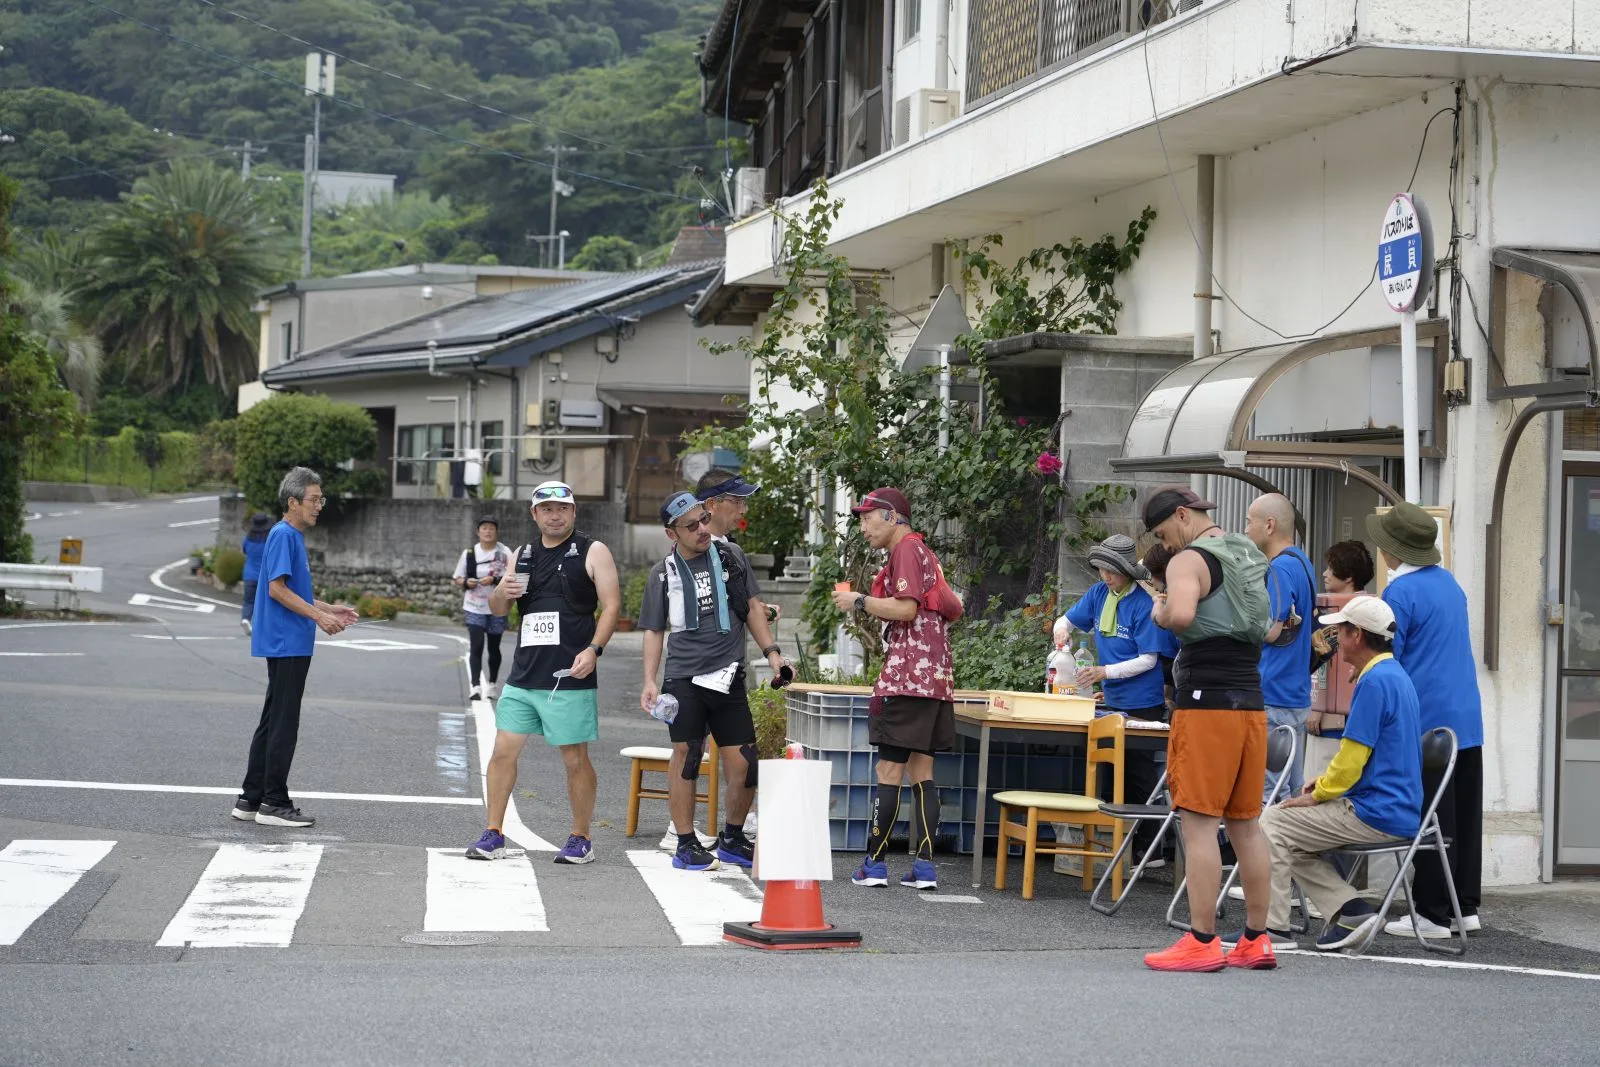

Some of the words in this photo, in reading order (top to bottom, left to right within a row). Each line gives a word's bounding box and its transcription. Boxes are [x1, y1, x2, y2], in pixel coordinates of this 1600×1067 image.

[1384, 214, 1414, 239] バスのりば
[694, 571, 710, 580] 30th
[533, 622, 555, 634] 409
